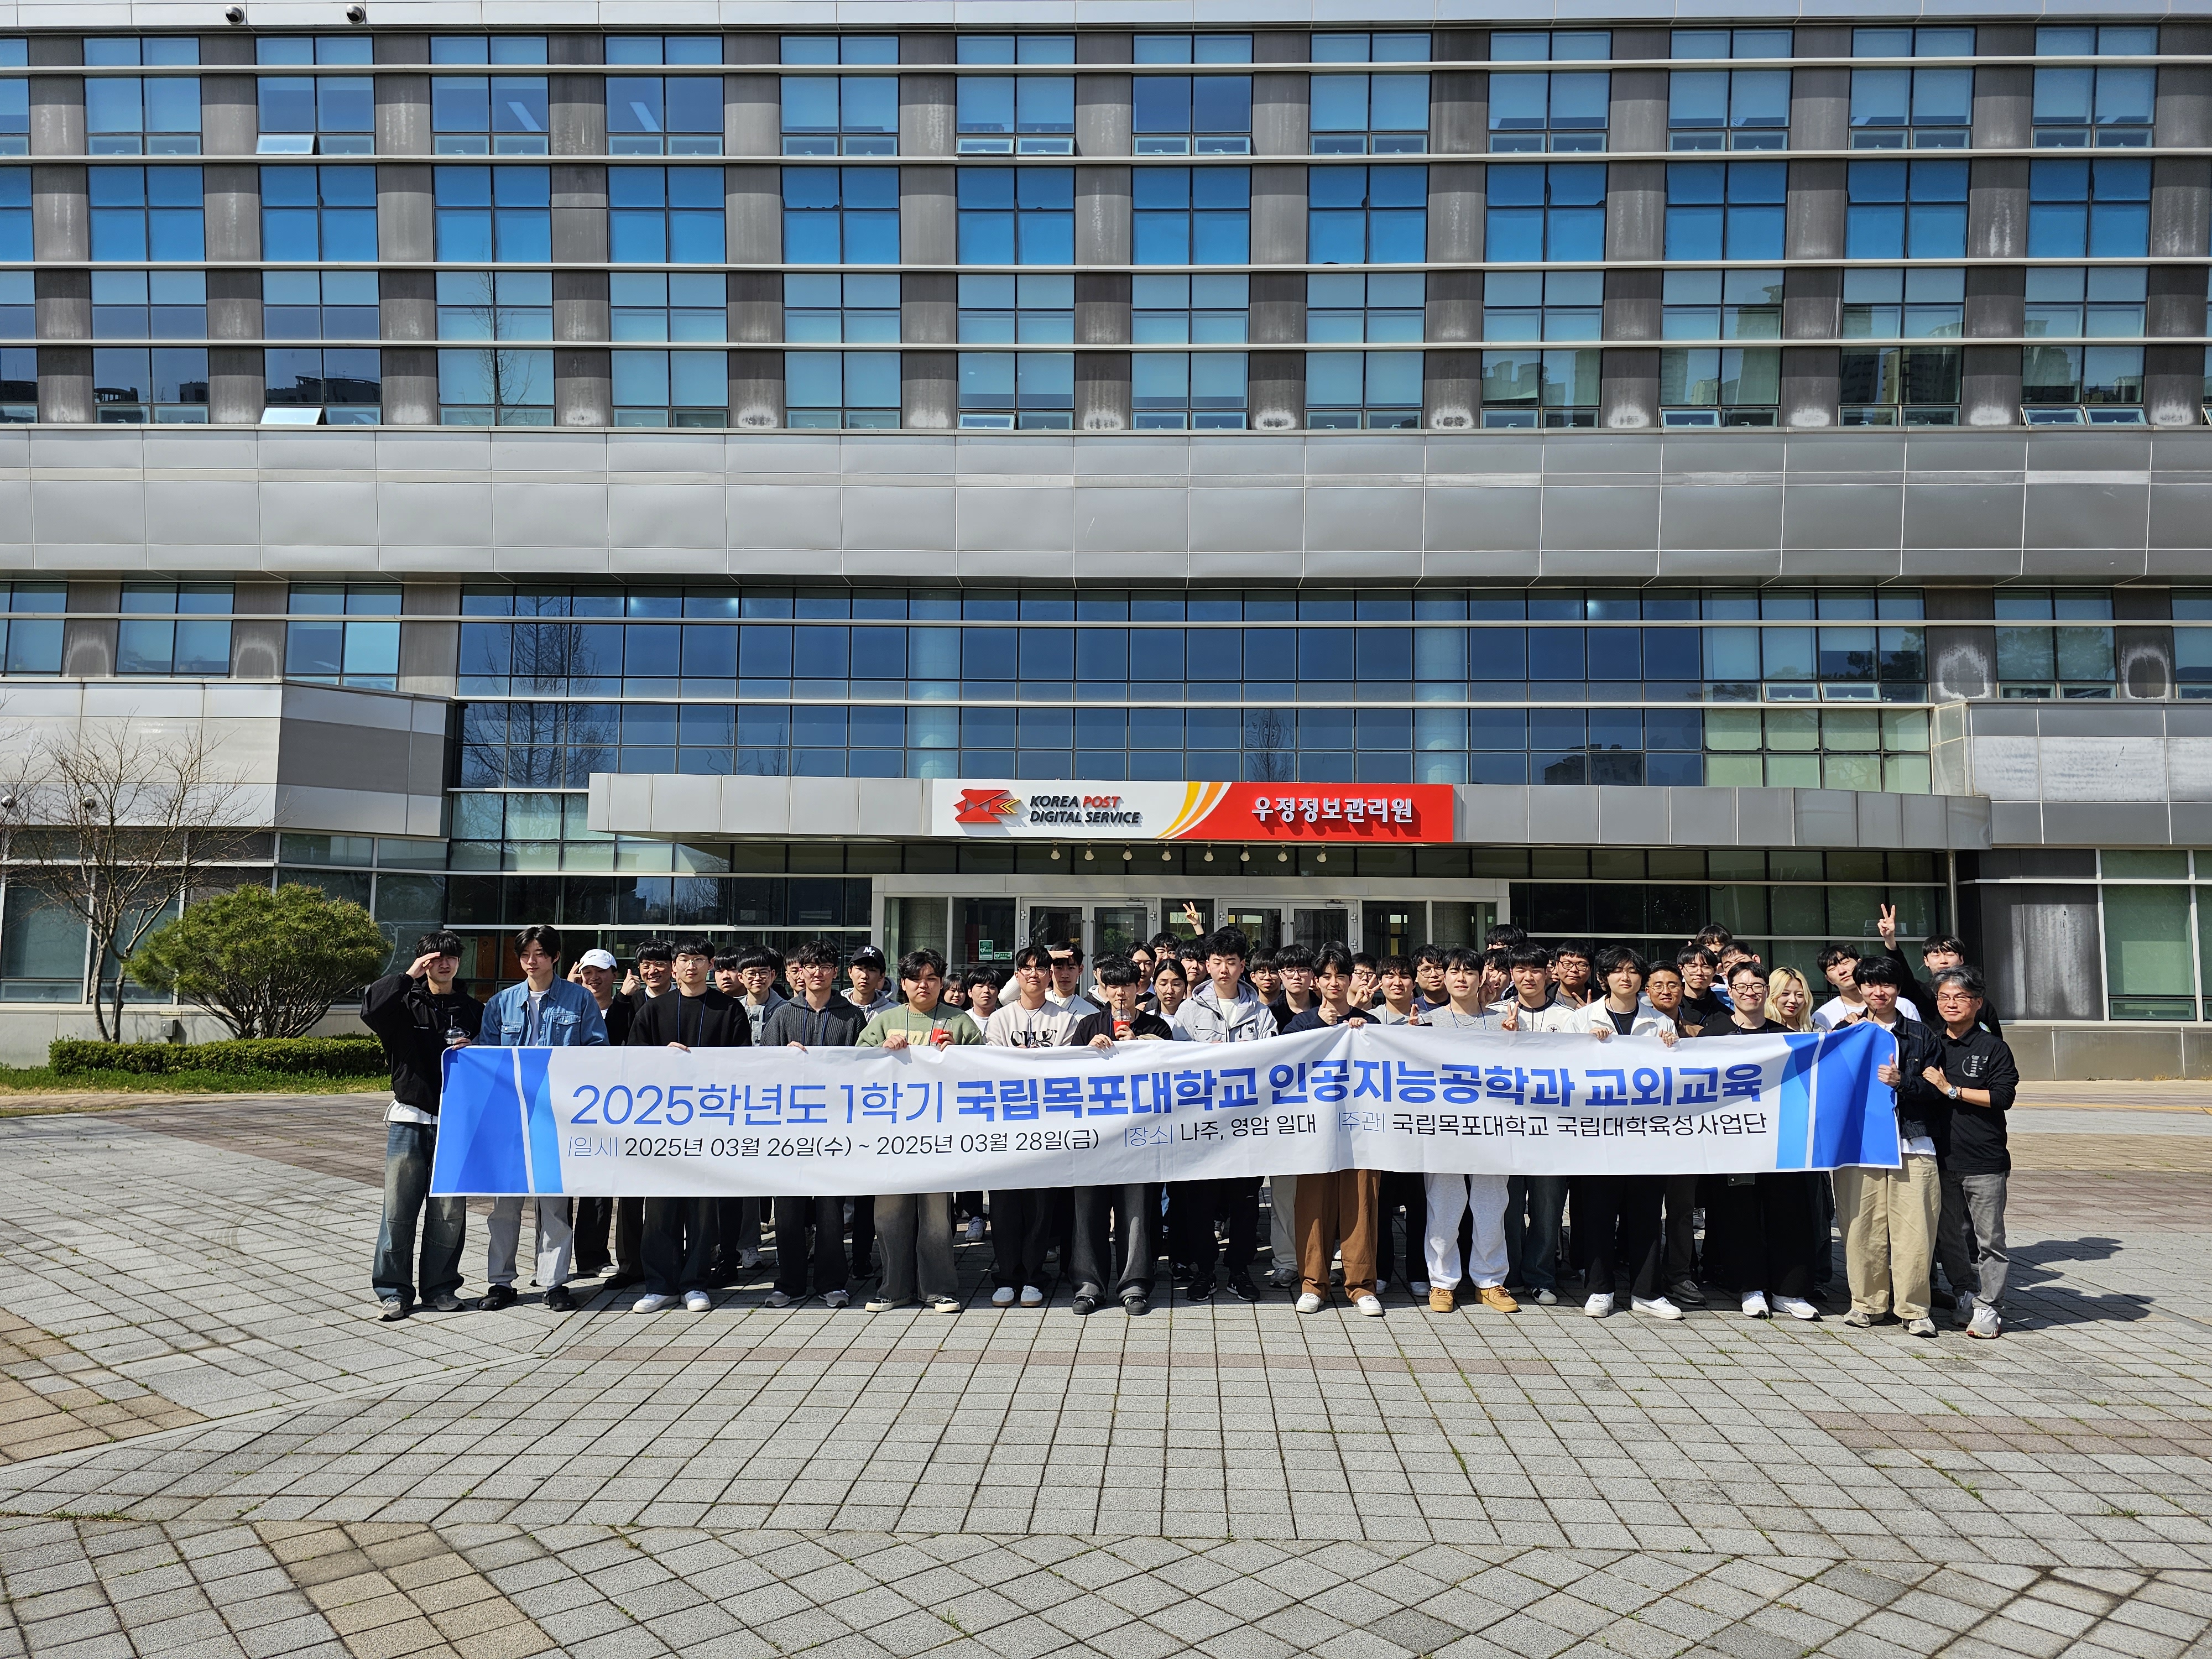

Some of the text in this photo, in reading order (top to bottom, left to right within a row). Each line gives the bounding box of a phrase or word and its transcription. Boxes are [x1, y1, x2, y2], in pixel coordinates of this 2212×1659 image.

[1030, 795, 1120, 808] KOREA POST
[1251, 797, 1412, 823] 우정정보관리원
[1030, 811, 1141, 823] DIGITAL SERVICE
[571, 1060, 1762, 1126] 2025학년도 1학기 국립목포대학교 인공지능공학과 교외교육
[625, 1137, 703, 1157] 2025년
[711, 1137, 760, 1157] 03월
[767, 1136, 852, 1157] 26일(수)
[877, 1134, 952, 1155] 2025년
[961, 1133, 1008, 1152] 03월
[1015, 1128, 1099, 1151] 28일(금)
[1181, 1122, 1225, 1142] 나주,
[1231, 1117, 1270, 1138] 영암
[1276, 1114, 1316, 1135] 일대
[1392, 1113, 1550, 1138] 국립목포대학교
[1557, 1112, 1767, 1138] 국립대학육성사업단
